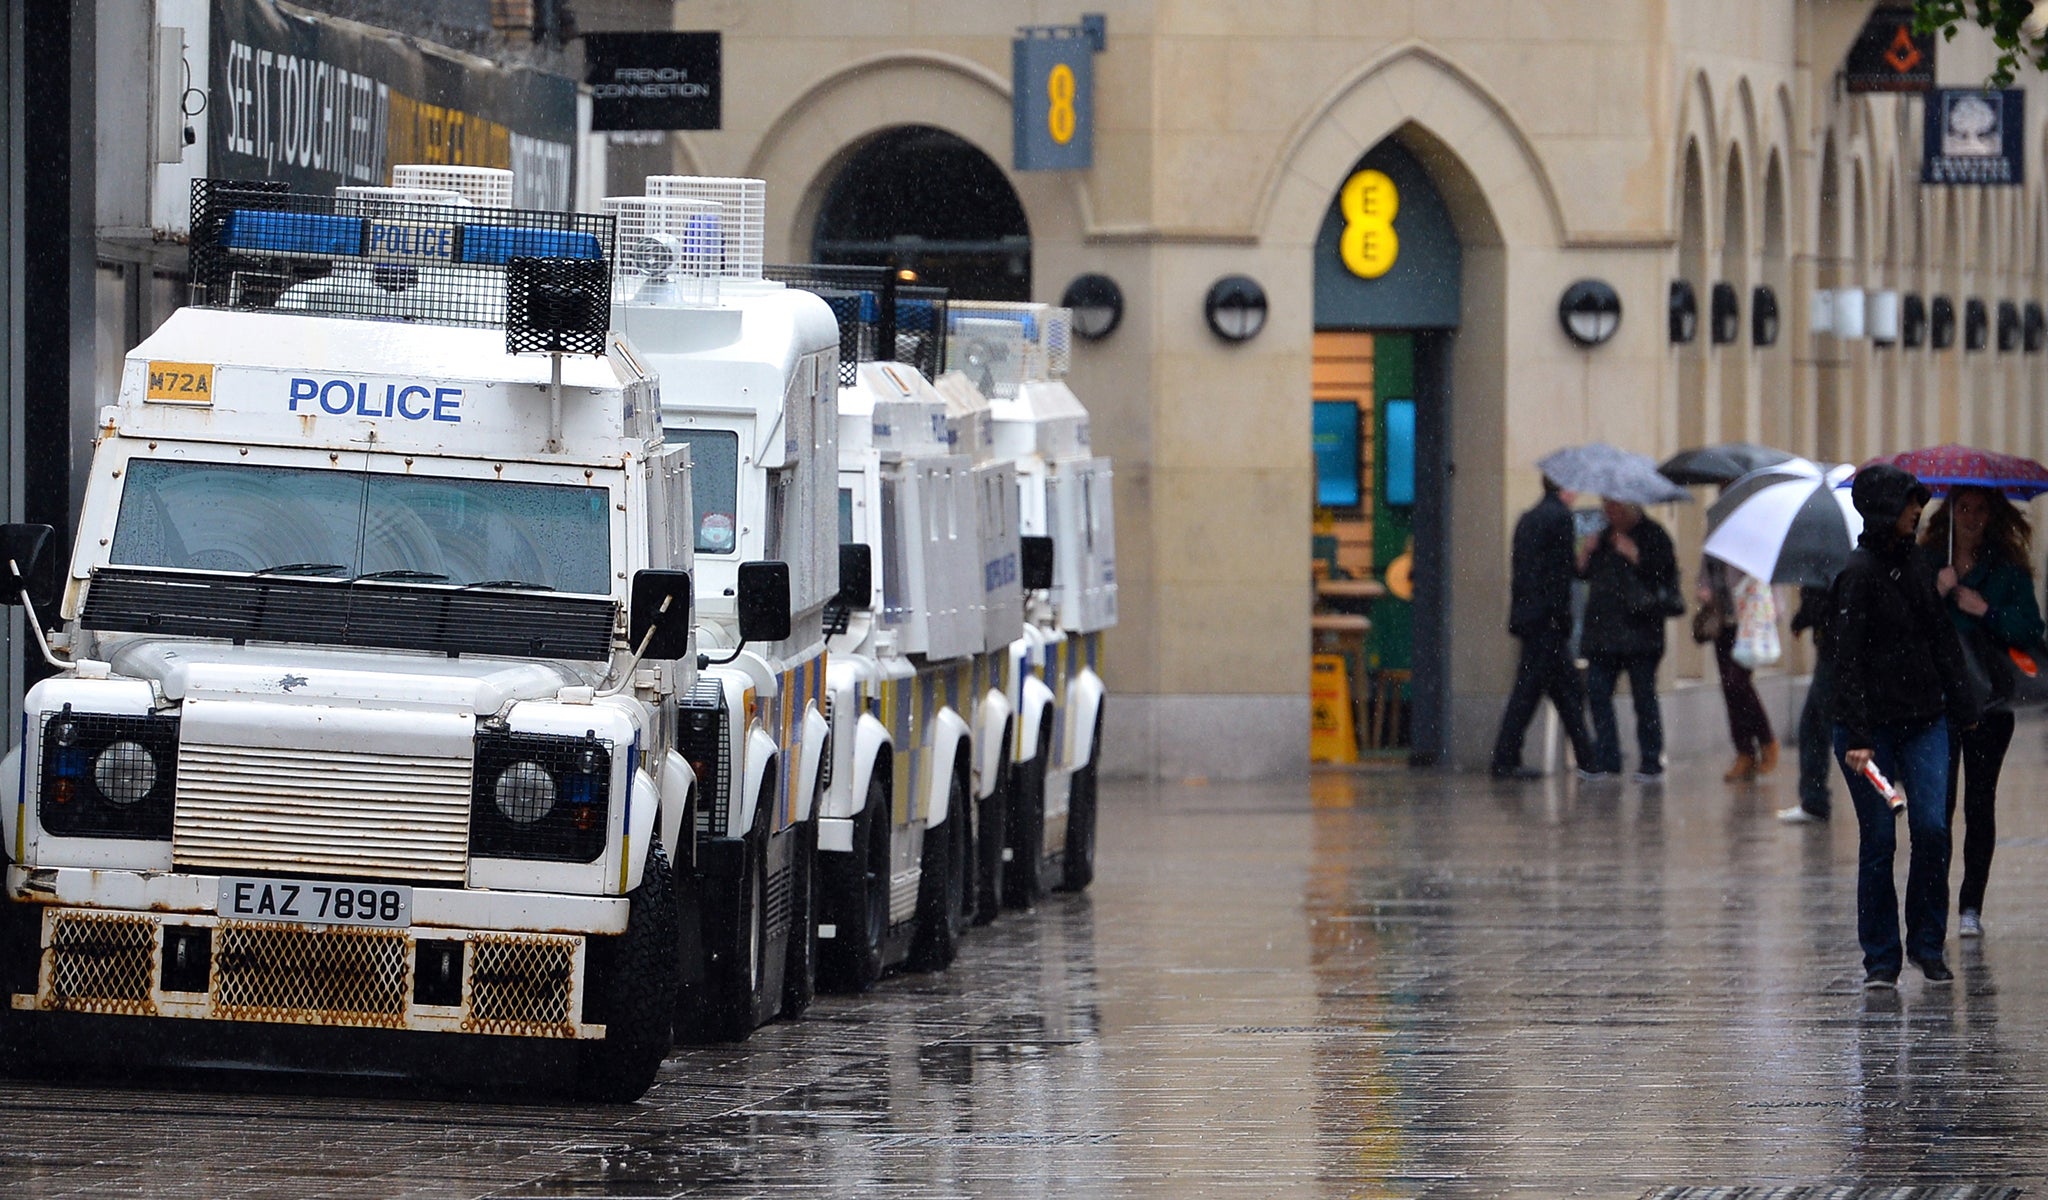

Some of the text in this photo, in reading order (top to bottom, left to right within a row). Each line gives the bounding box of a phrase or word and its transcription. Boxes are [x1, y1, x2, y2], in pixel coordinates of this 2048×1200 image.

[593, 83, 711, 98] CONNECTION
[614, 67, 688, 82] FRENCH
[227, 39, 253, 155] SEE
[277, 54, 335, 171] TOUCH
[371, 224, 452, 257] POLICE
[149, 371, 208, 393] M72A
[288, 377, 462, 423] POLICE
[234, 882, 401, 921] EAZ 7898
